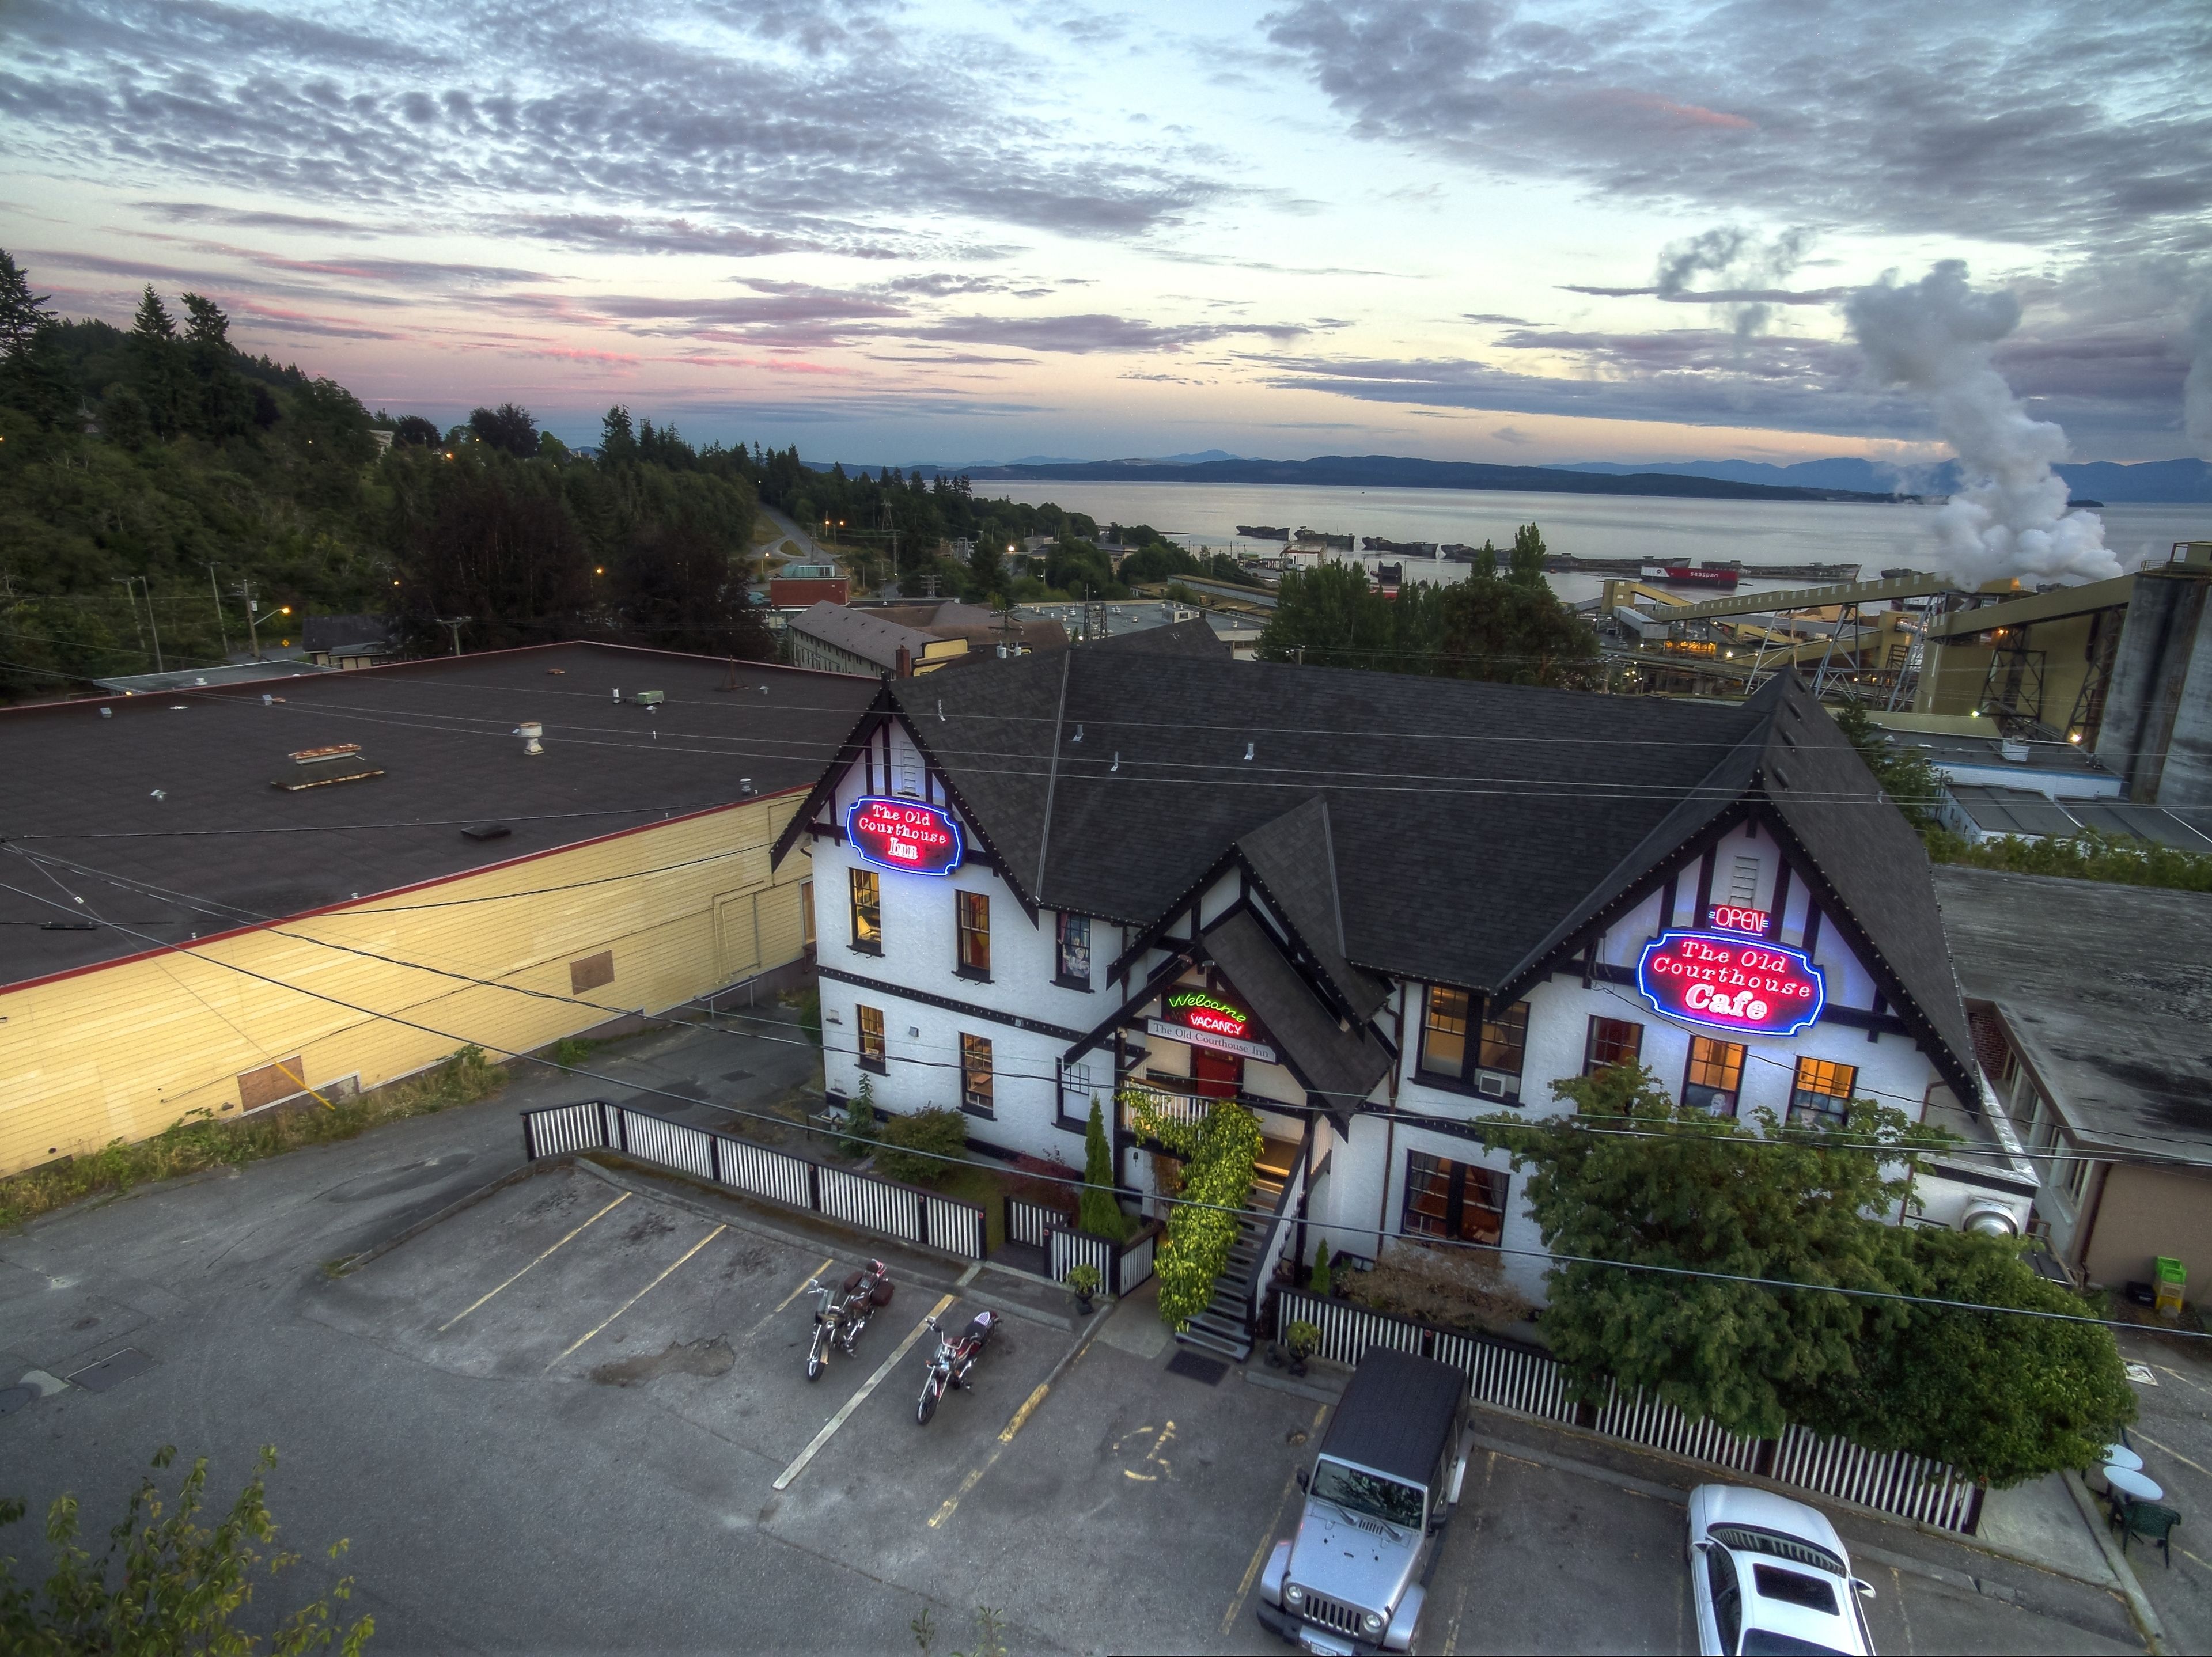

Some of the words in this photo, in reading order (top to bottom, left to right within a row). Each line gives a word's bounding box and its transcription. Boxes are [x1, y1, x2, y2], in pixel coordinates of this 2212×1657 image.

[873, 804, 901, 820] The
[905, 810, 931, 826] Old
[859, 817, 947, 844] Courthouse
[888, 837, 919, 860] Inn
[1715, 907, 1766, 932] OPEN
[1682, 941, 1729, 964] The
[1741, 951, 1786, 973] Old
[1653, 957, 1811, 998] Courthouse
[1169, 994, 1247, 1023] Welcome
[1685, 983, 1768, 1021] Cafe
[1190, 1014, 1244, 1035] VACANCY
[1153, 1023, 1172, 1035] The
[1176, 1027, 1192, 1040] Old
[1195, 1034, 1249, 1053] Courthouse
[1252, 1045, 1269, 1058] Inn
